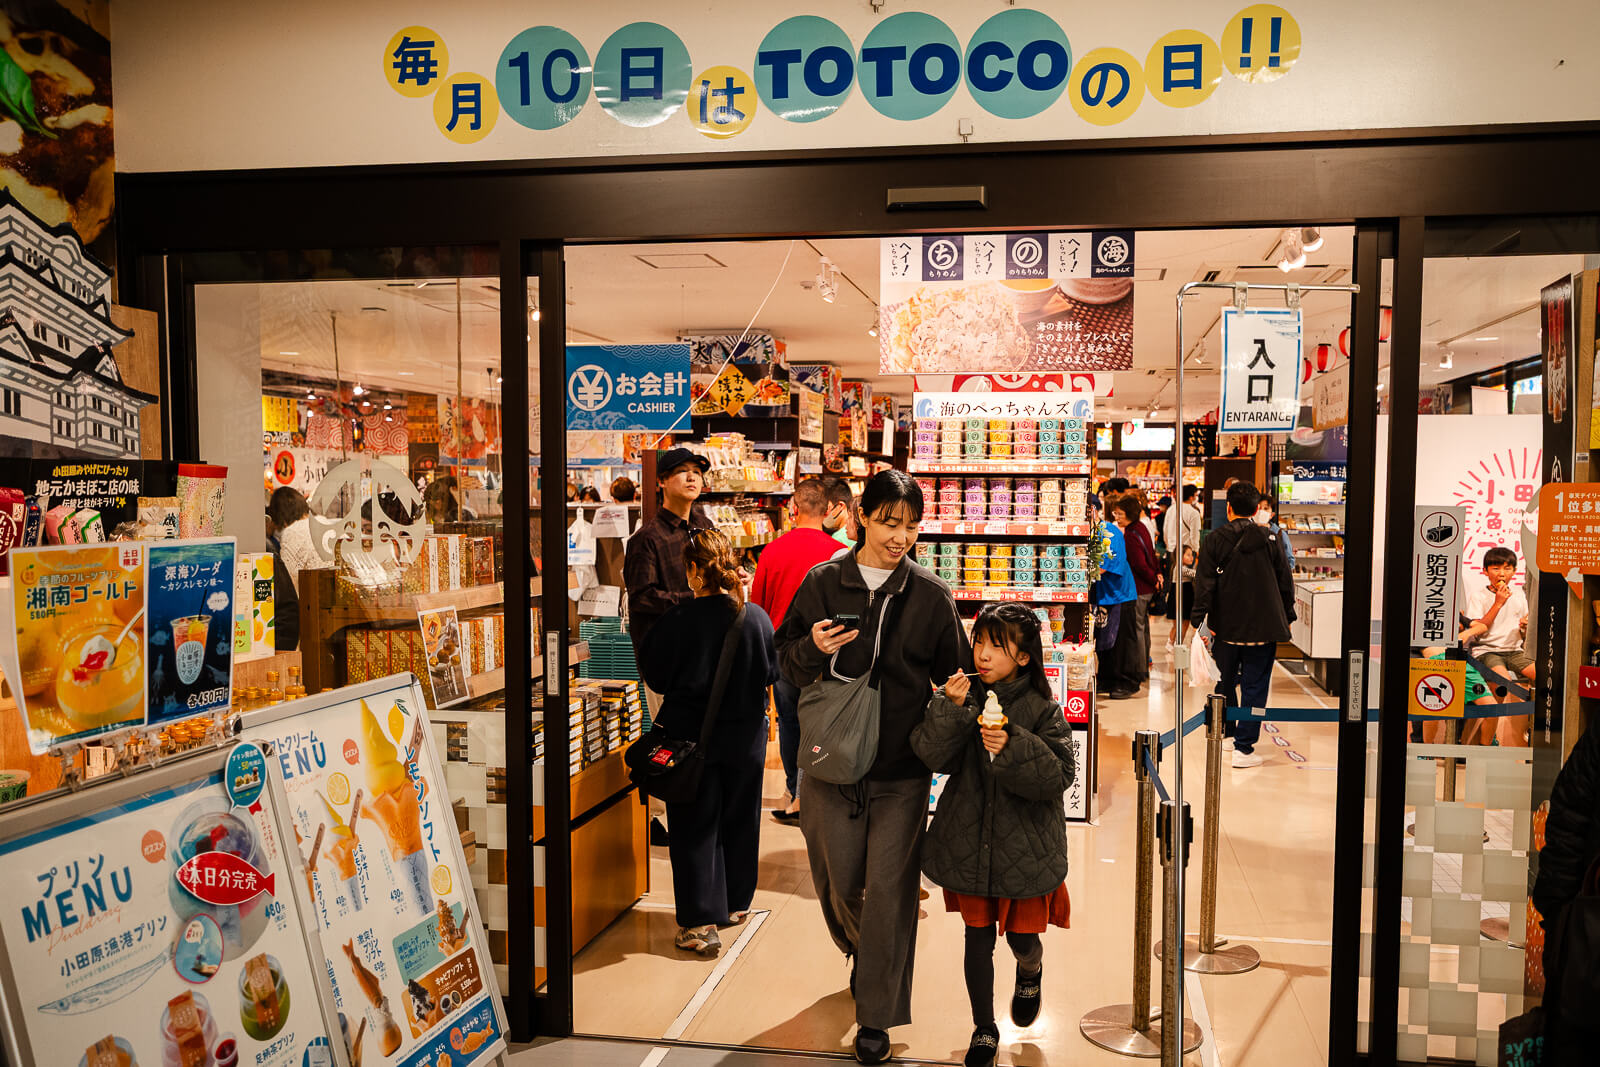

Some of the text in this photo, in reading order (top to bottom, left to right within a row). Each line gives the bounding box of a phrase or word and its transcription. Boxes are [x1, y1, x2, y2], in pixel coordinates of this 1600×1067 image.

[1036, 322, 1082, 332] 海の素材を
[1036, 332, 1130, 342] そのまんまプレスして
[1247, 338, 1276, 404] 入口
[615, 372, 687, 397] お会計
[627, 402, 676, 413] CASHIER
[940, 400, 1070, 416] 海のぺっちゃんズ
[1226, 411, 1292, 422] ENTARANCE
[35, 479, 140, 497] 地元かまぼこ店の味
[165, 560, 222, 581] 深海ソーダ
[27, 581, 136, 610] 湘南ゴールド
[1423, 554, 1448, 641] 防犯カメラ作動中
[187, 687, 225, 709] 各450円
[1352, 672, 1360, 710] 押して下さい
[404, 746, 441, 863] レモンソフト
[37, 854, 105, 898] プリン
[187, 867, 258, 891] 本日分完売
[21, 867, 133, 943] MENU
[60, 915, 168, 978] 小田原漁港プリン
